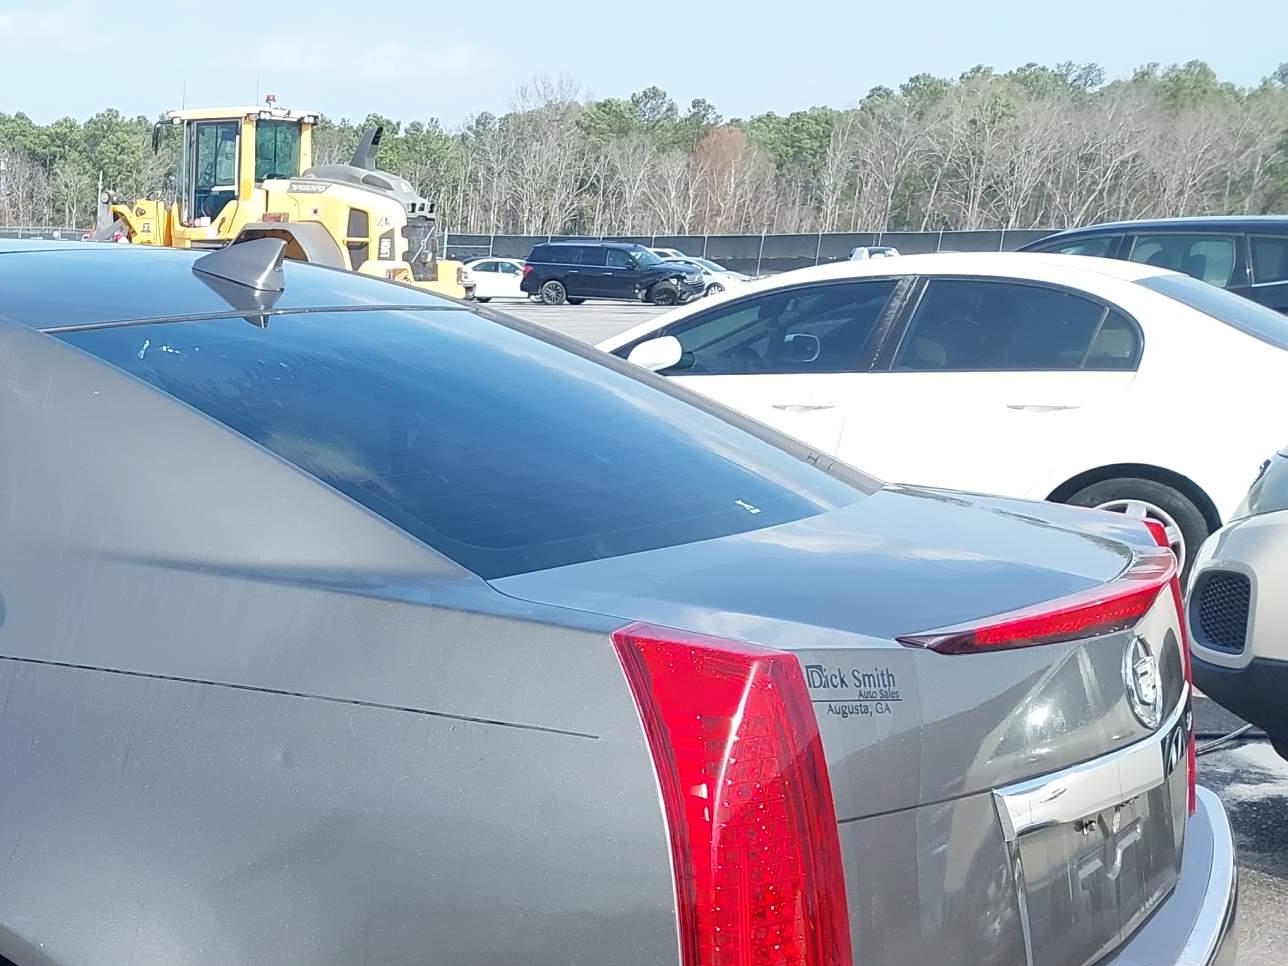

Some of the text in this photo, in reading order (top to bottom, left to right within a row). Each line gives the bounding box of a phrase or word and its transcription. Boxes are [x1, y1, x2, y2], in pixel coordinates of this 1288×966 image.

[291, 184, 326, 193] VOLVO
[805, 665, 896, 689] Dick Smith
[857, 688, 900, 699] Auto Sales
[826, 702, 892, 718] Augusta, GA
